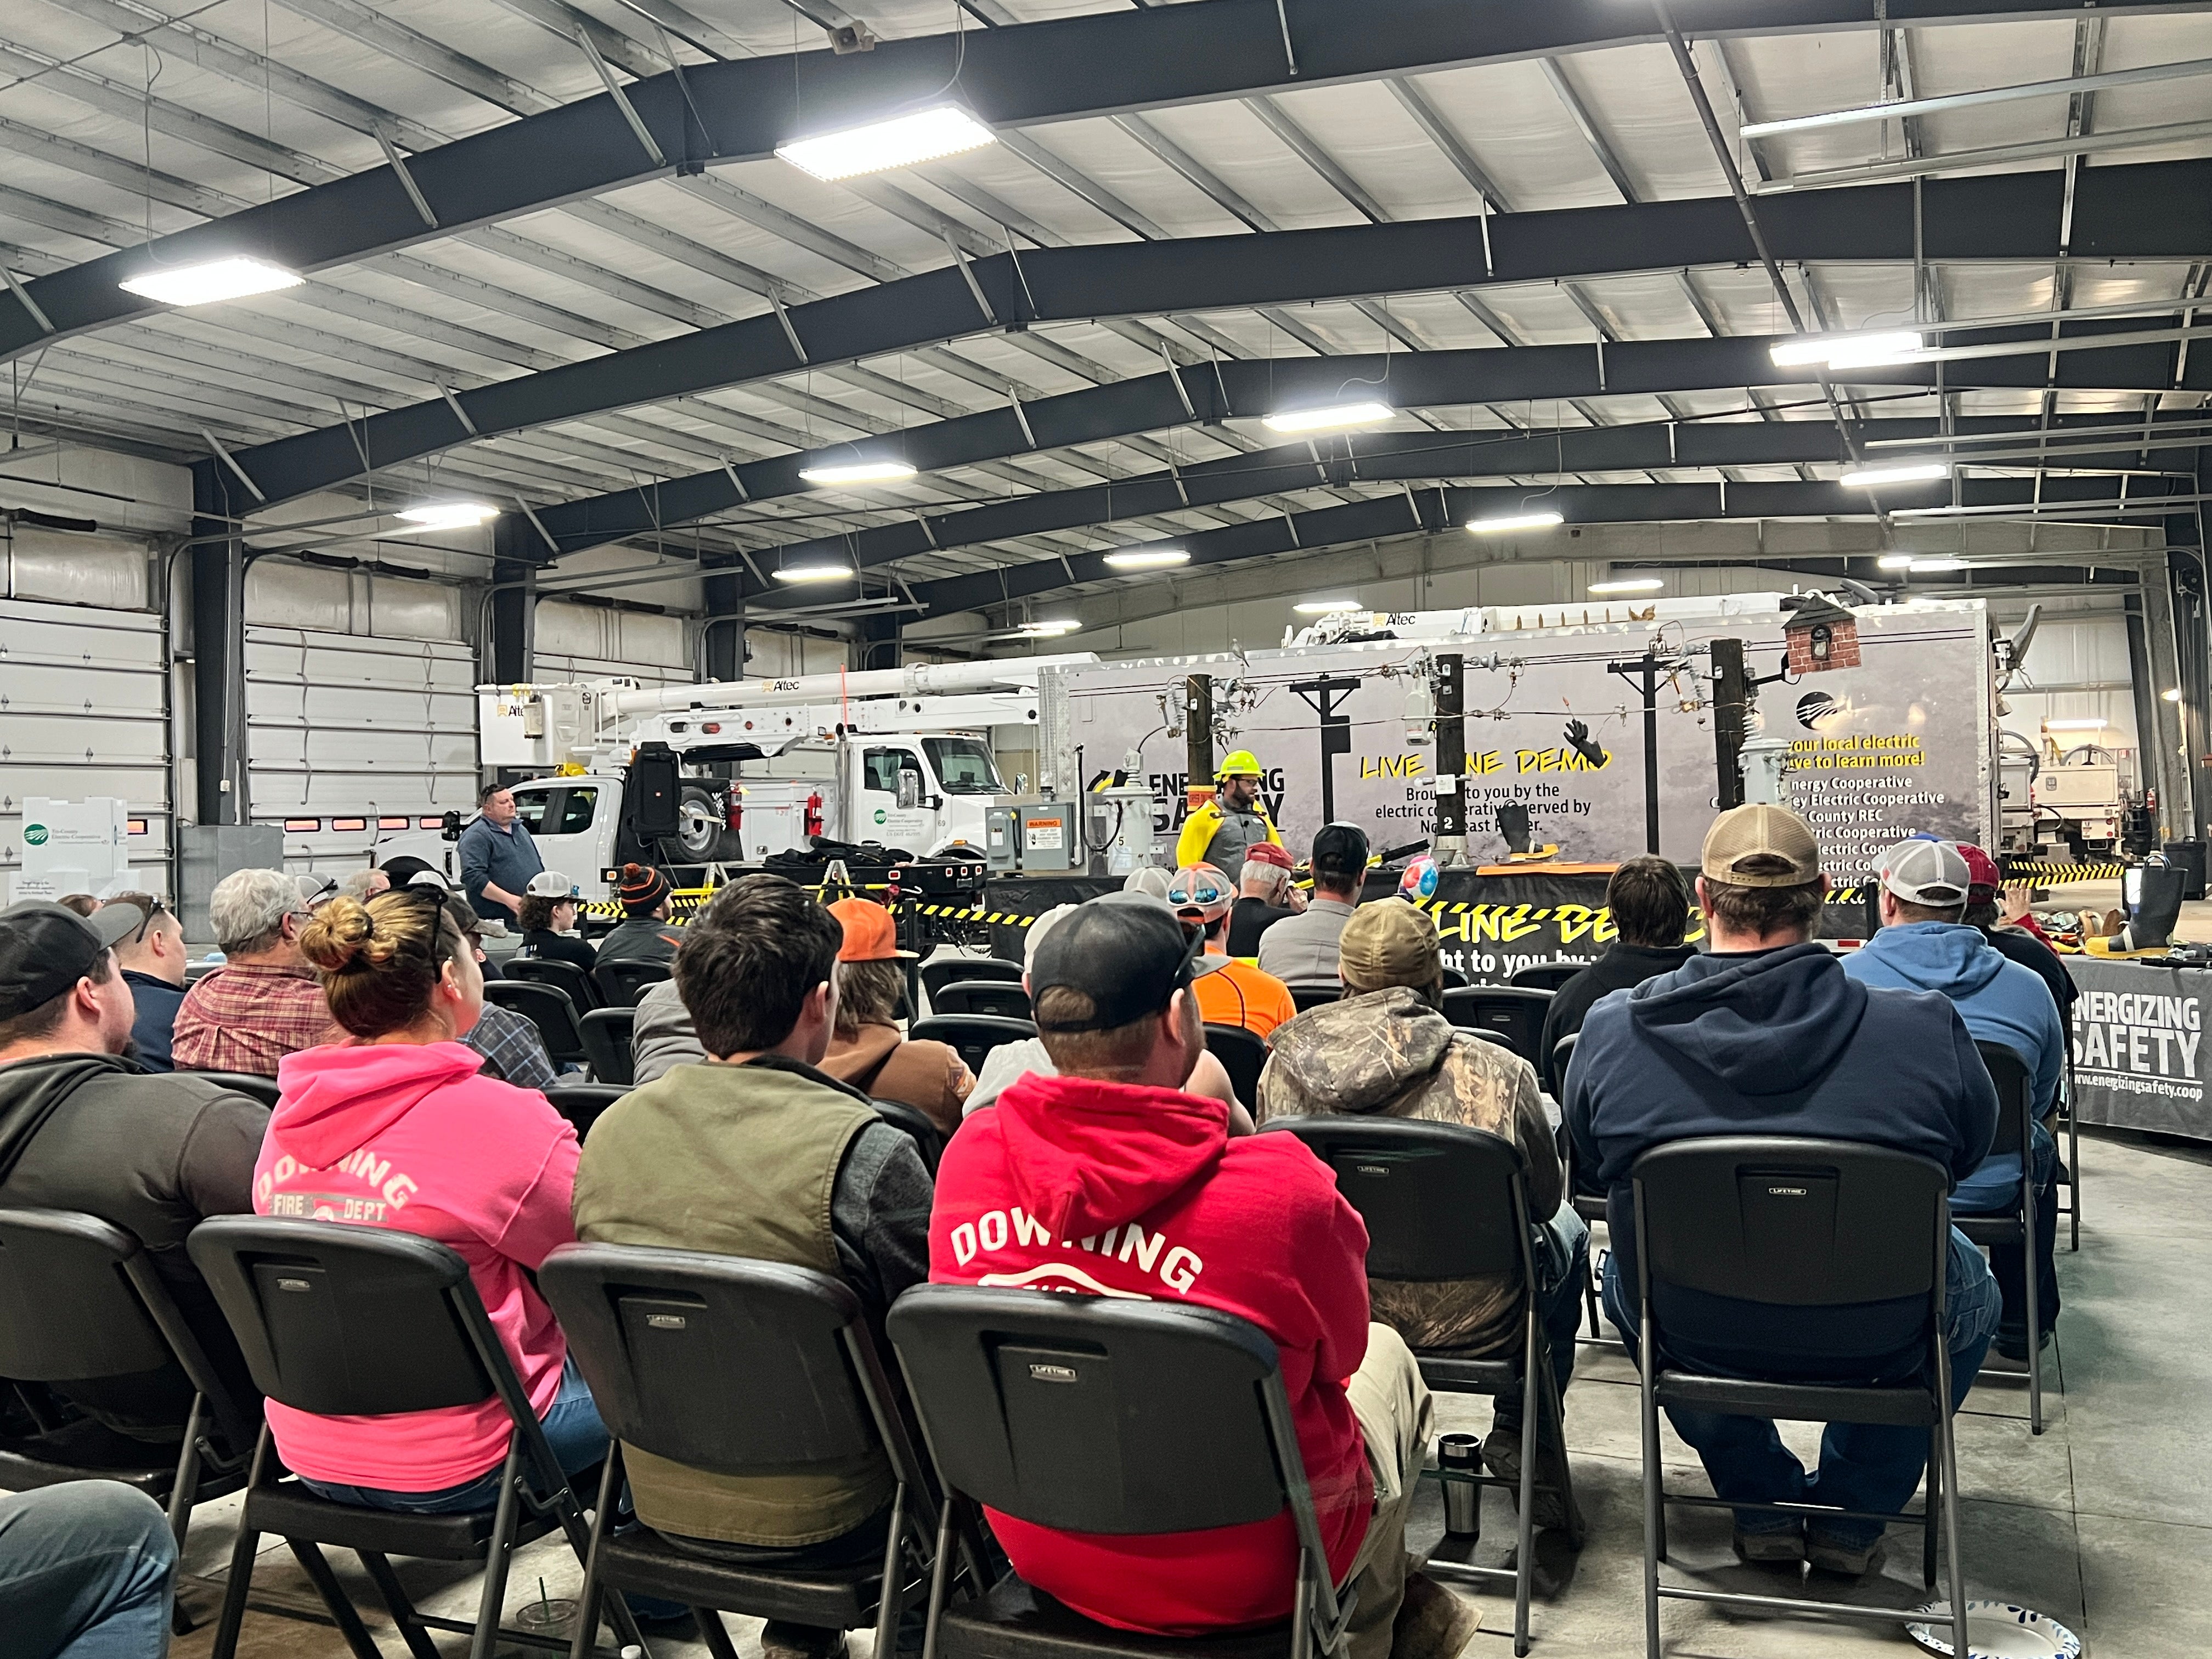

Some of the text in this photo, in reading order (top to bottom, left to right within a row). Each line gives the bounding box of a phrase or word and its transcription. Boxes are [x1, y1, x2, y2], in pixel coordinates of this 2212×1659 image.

[1386, 612, 1415, 626] Altec
[773, 681, 799, 691] Altec
[508, 706, 524, 716] Alt
[1822, 735, 1859, 751] local
[1861, 733, 1920, 750] electric
[1360, 754, 1427, 779] LIVE
[1465, 750, 1506, 775] NE
[1814, 755, 1832, 769] to
[1835, 754, 1875, 768] learn
[1878, 751, 1925, 767] more!
[1466, 786, 1480, 799] to
[1484, 787, 1509, 802] you
[1514, 784, 1531, 800] by
[1536, 783, 1559, 797] the
[1791, 775, 1912, 793] nergy Cooperative
[1375, 804, 1424, 818] electric
[1528, 799, 1568, 815] erved
[1573, 798, 1591, 816] by
[1810, 793, 1860, 806] Electric
[1861, 791, 1944, 808] Cooperative
[1443, 816, 1453, 830] 2
[1807, 810, 1855, 824] County
[1857, 809, 1883, 822] REC
[1834, 825, 1916, 840] Cooperative
[1118, 837, 1124, 846] 5
[1818, 842, 1858, 855] lectric
[1819, 859, 1852, 872] ectric
[1831, 875, 1860, 888] ctric
[1430, 904, 1542, 944] LINE
[1471, 949, 1496, 973] to
[273, 1194, 387, 1221] FIRE DEPT
[950, 1206, 1204, 1295] DOWING
